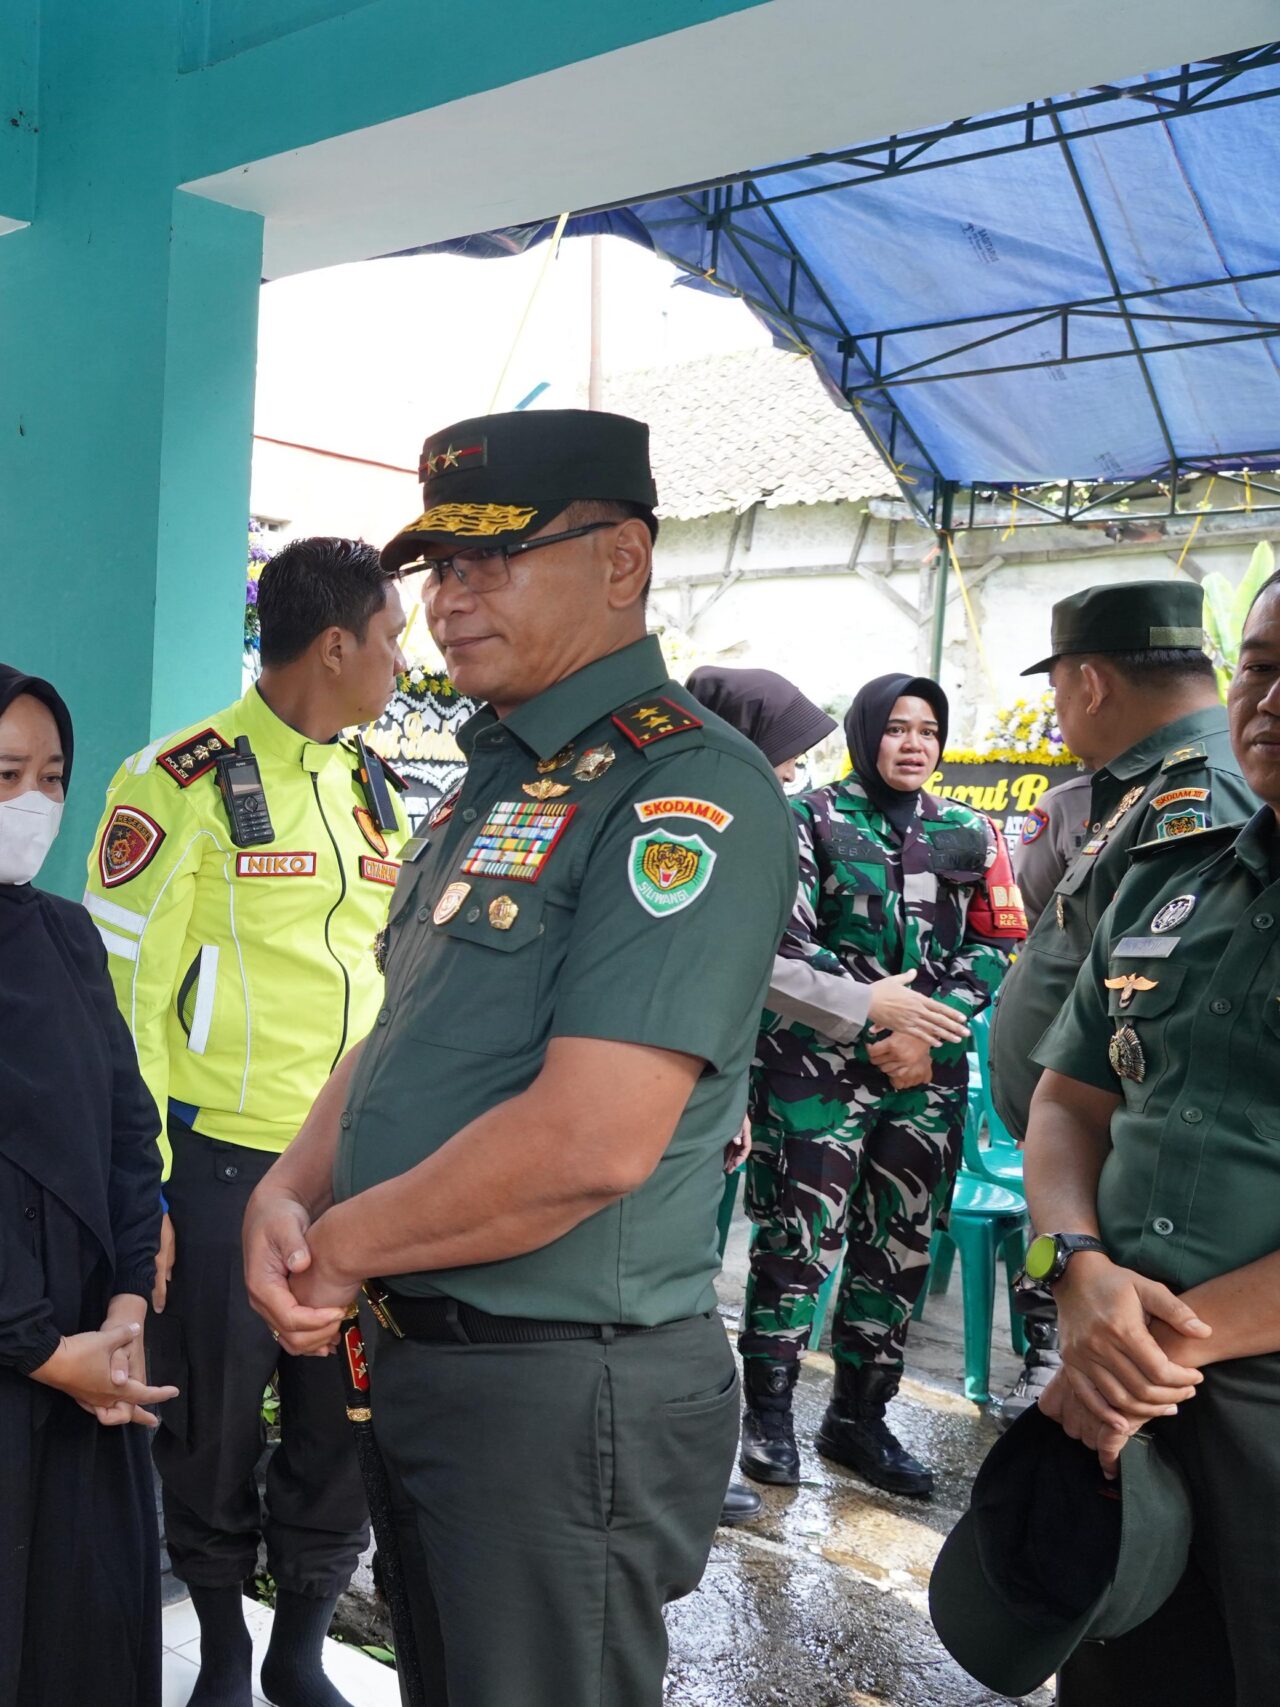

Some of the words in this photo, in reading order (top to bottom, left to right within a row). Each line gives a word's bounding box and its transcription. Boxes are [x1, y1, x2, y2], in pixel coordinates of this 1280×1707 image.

[164, 755, 190, 780] POLISI
[643, 800, 709, 818] SKODAM
[709, 808, 724, 826] III
[247, 856, 307, 873] NIKO
